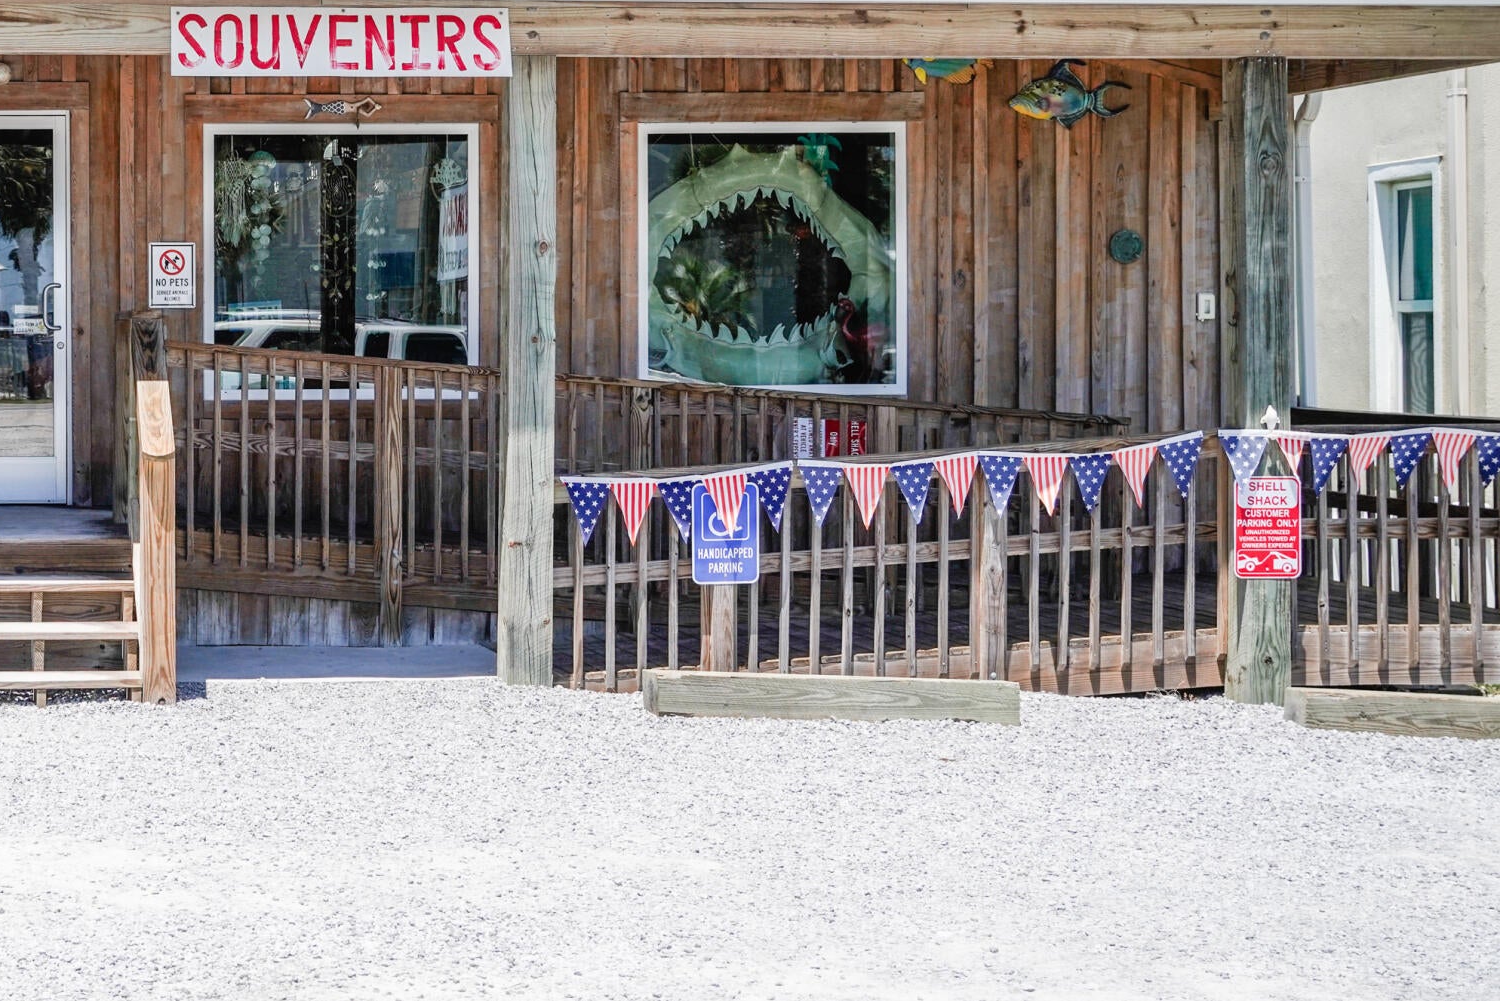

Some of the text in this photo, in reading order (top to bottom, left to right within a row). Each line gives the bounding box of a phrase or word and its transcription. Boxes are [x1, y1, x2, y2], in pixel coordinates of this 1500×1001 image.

[178, 13, 502, 72] SOUVENIRS
[156, 279, 189, 287] NO PETS
[1248, 481, 1287, 491] SHELL
[1247, 496, 1288, 505] SHACK
[1245, 509, 1290, 517] CUSTOMER
[1237, 519, 1298, 527] PARKING ONLY
[697, 547, 753, 559] HANDICAPPED
[708, 562, 743, 573] PARKING
